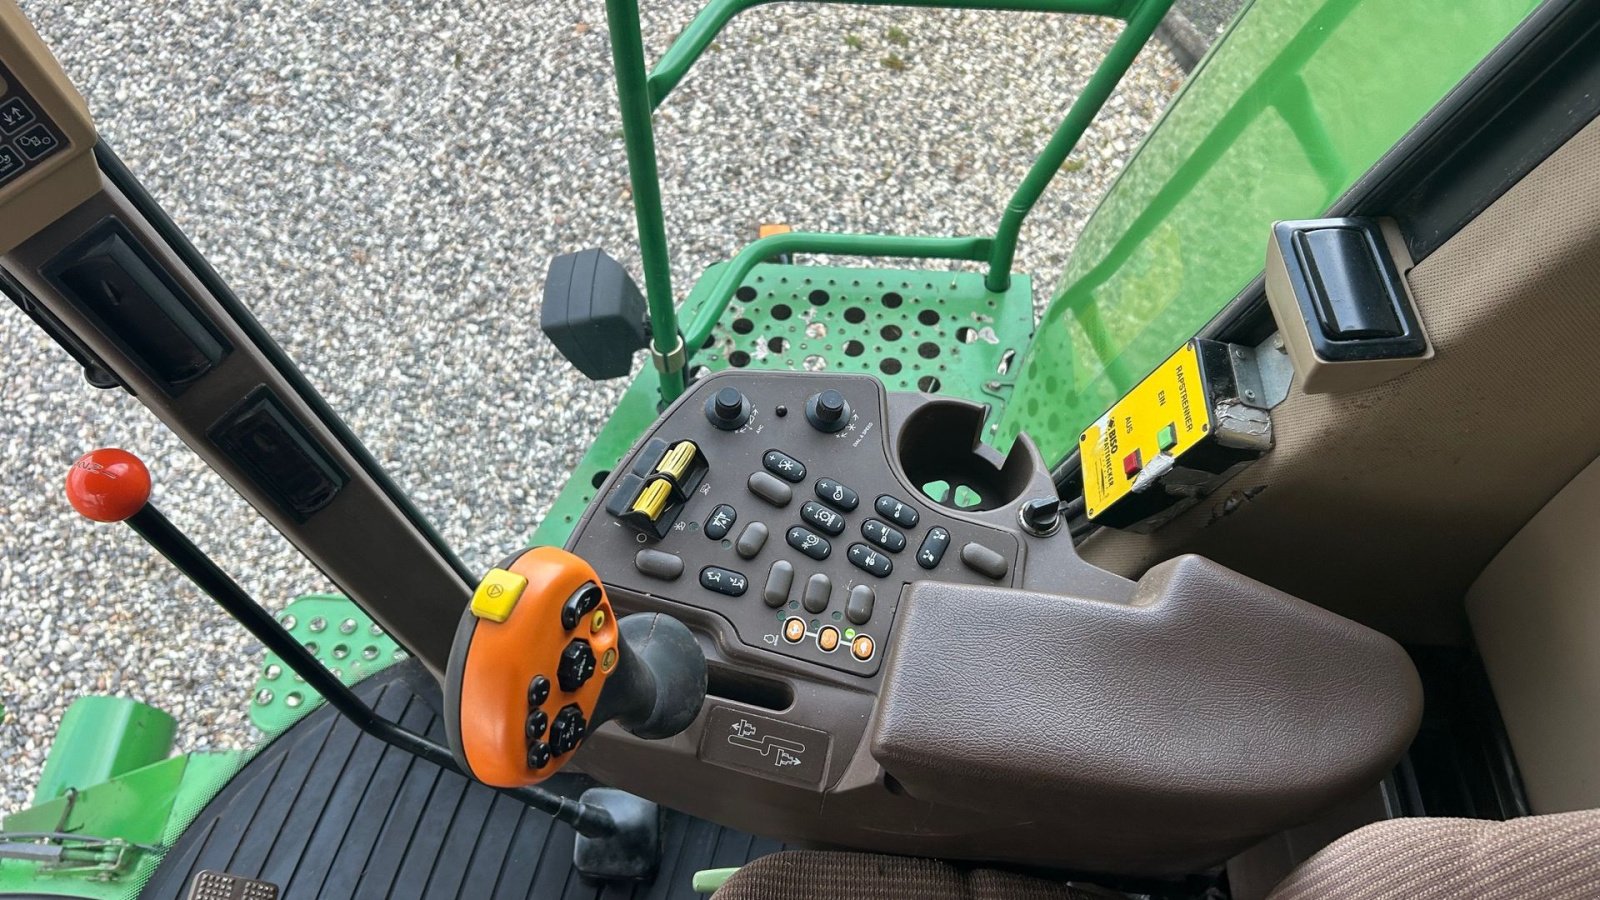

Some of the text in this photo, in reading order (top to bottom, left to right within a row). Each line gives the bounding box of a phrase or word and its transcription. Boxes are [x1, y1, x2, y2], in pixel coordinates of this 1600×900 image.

[1158, 390, 1167, 406] EIN
[1176, 365, 1193, 433] RAPSTRENNER
[1125, 416, 1133, 434] AUS
[1108, 429, 1118, 454] BISO
